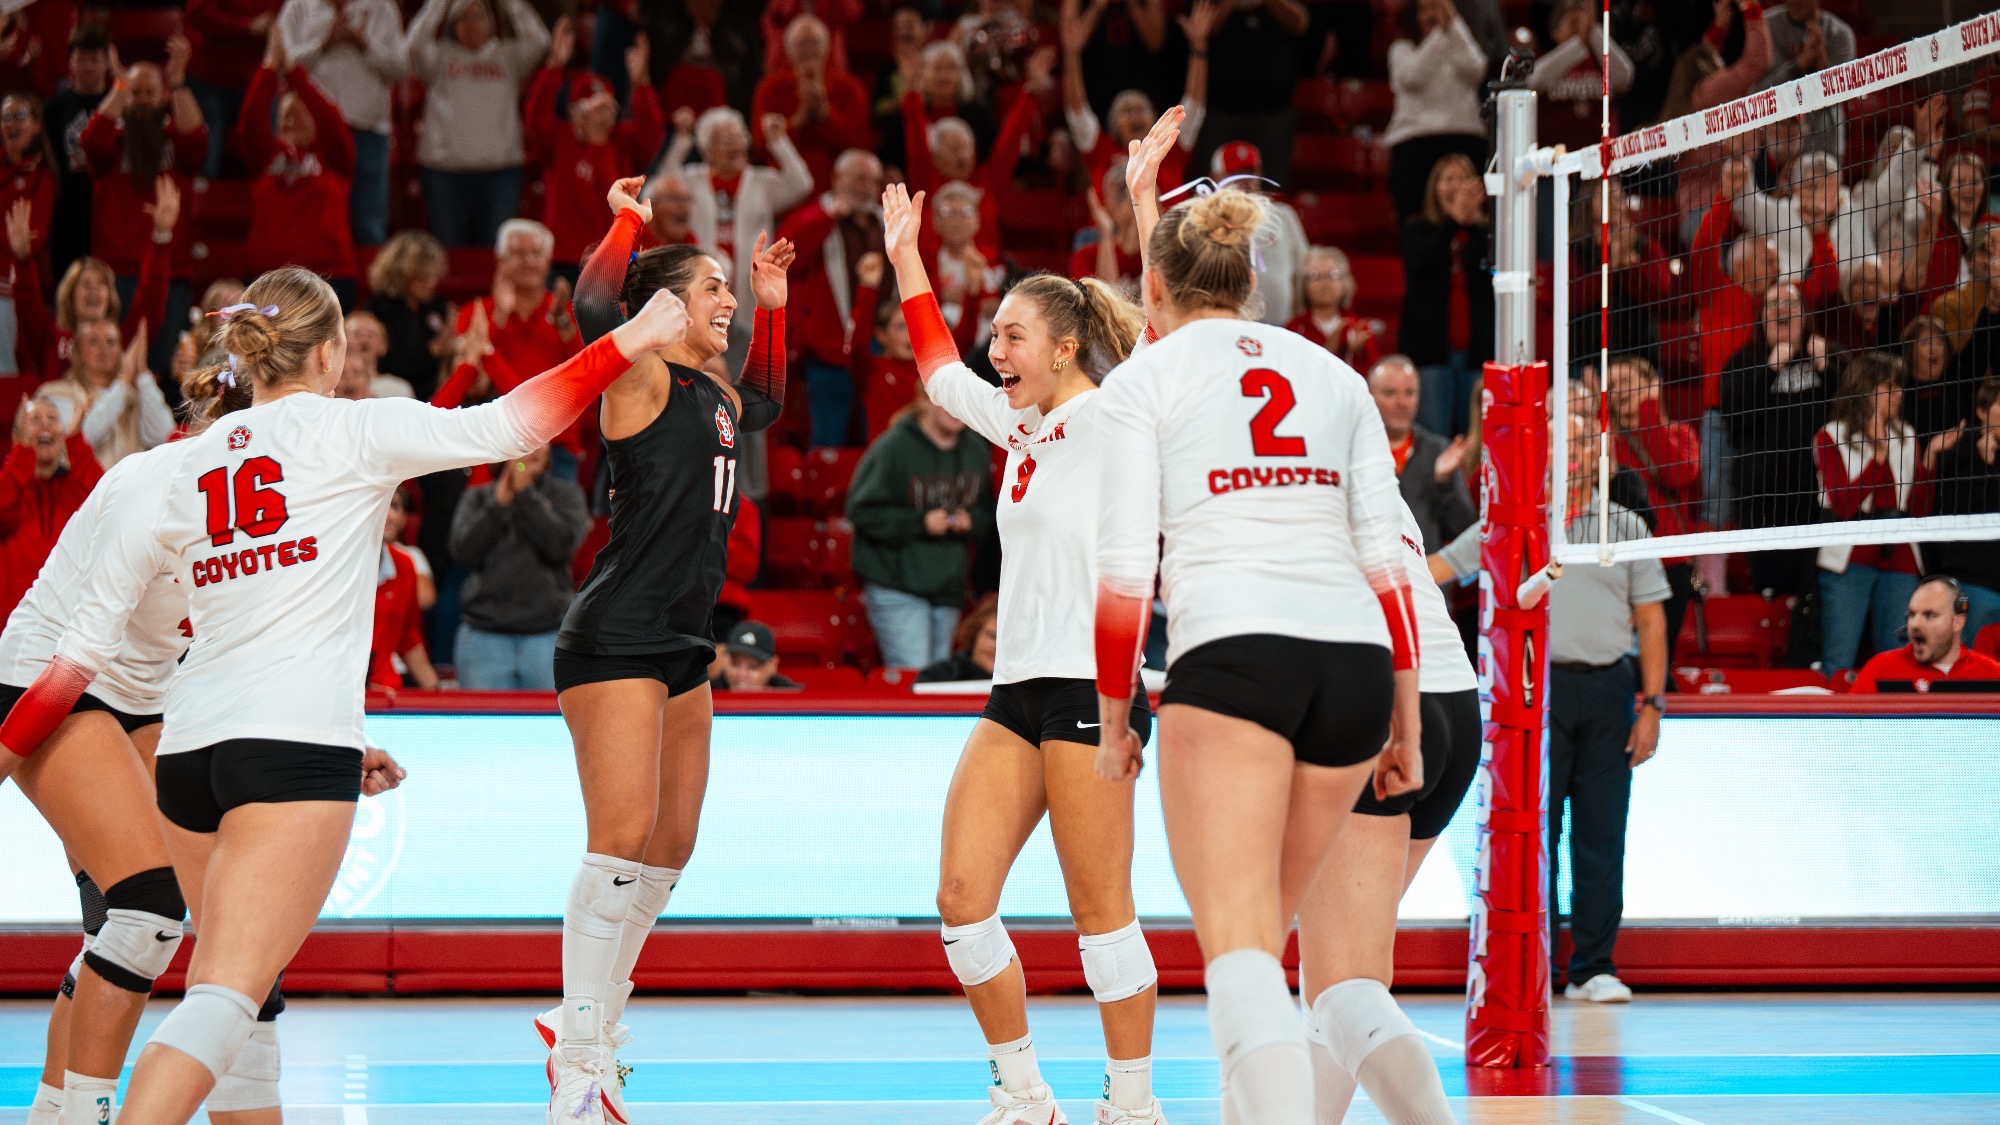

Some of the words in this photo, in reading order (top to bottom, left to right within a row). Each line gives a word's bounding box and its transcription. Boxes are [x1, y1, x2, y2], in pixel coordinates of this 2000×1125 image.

[1961, 17, 1989, 51] SOUTH
[1820, 66, 1846, 97] SOUTH
[1845, 58, 1875, 90] DAKOTA
[1874, 46, 1908, 80] COYOTES
[1704, 108, 1724, 135] SOUTH
[1723, 100, 1749, 130] DAKOTA
[1748, 89, 1777, 121] COYOTES
[1240, 368, 1307, 457] 2
[198, 455, 290, 547] 16
[713, 456, 736, 514] 11
[1011, 454, 1037, 503] 9
[192, 535, 318, 588] COYOTES
